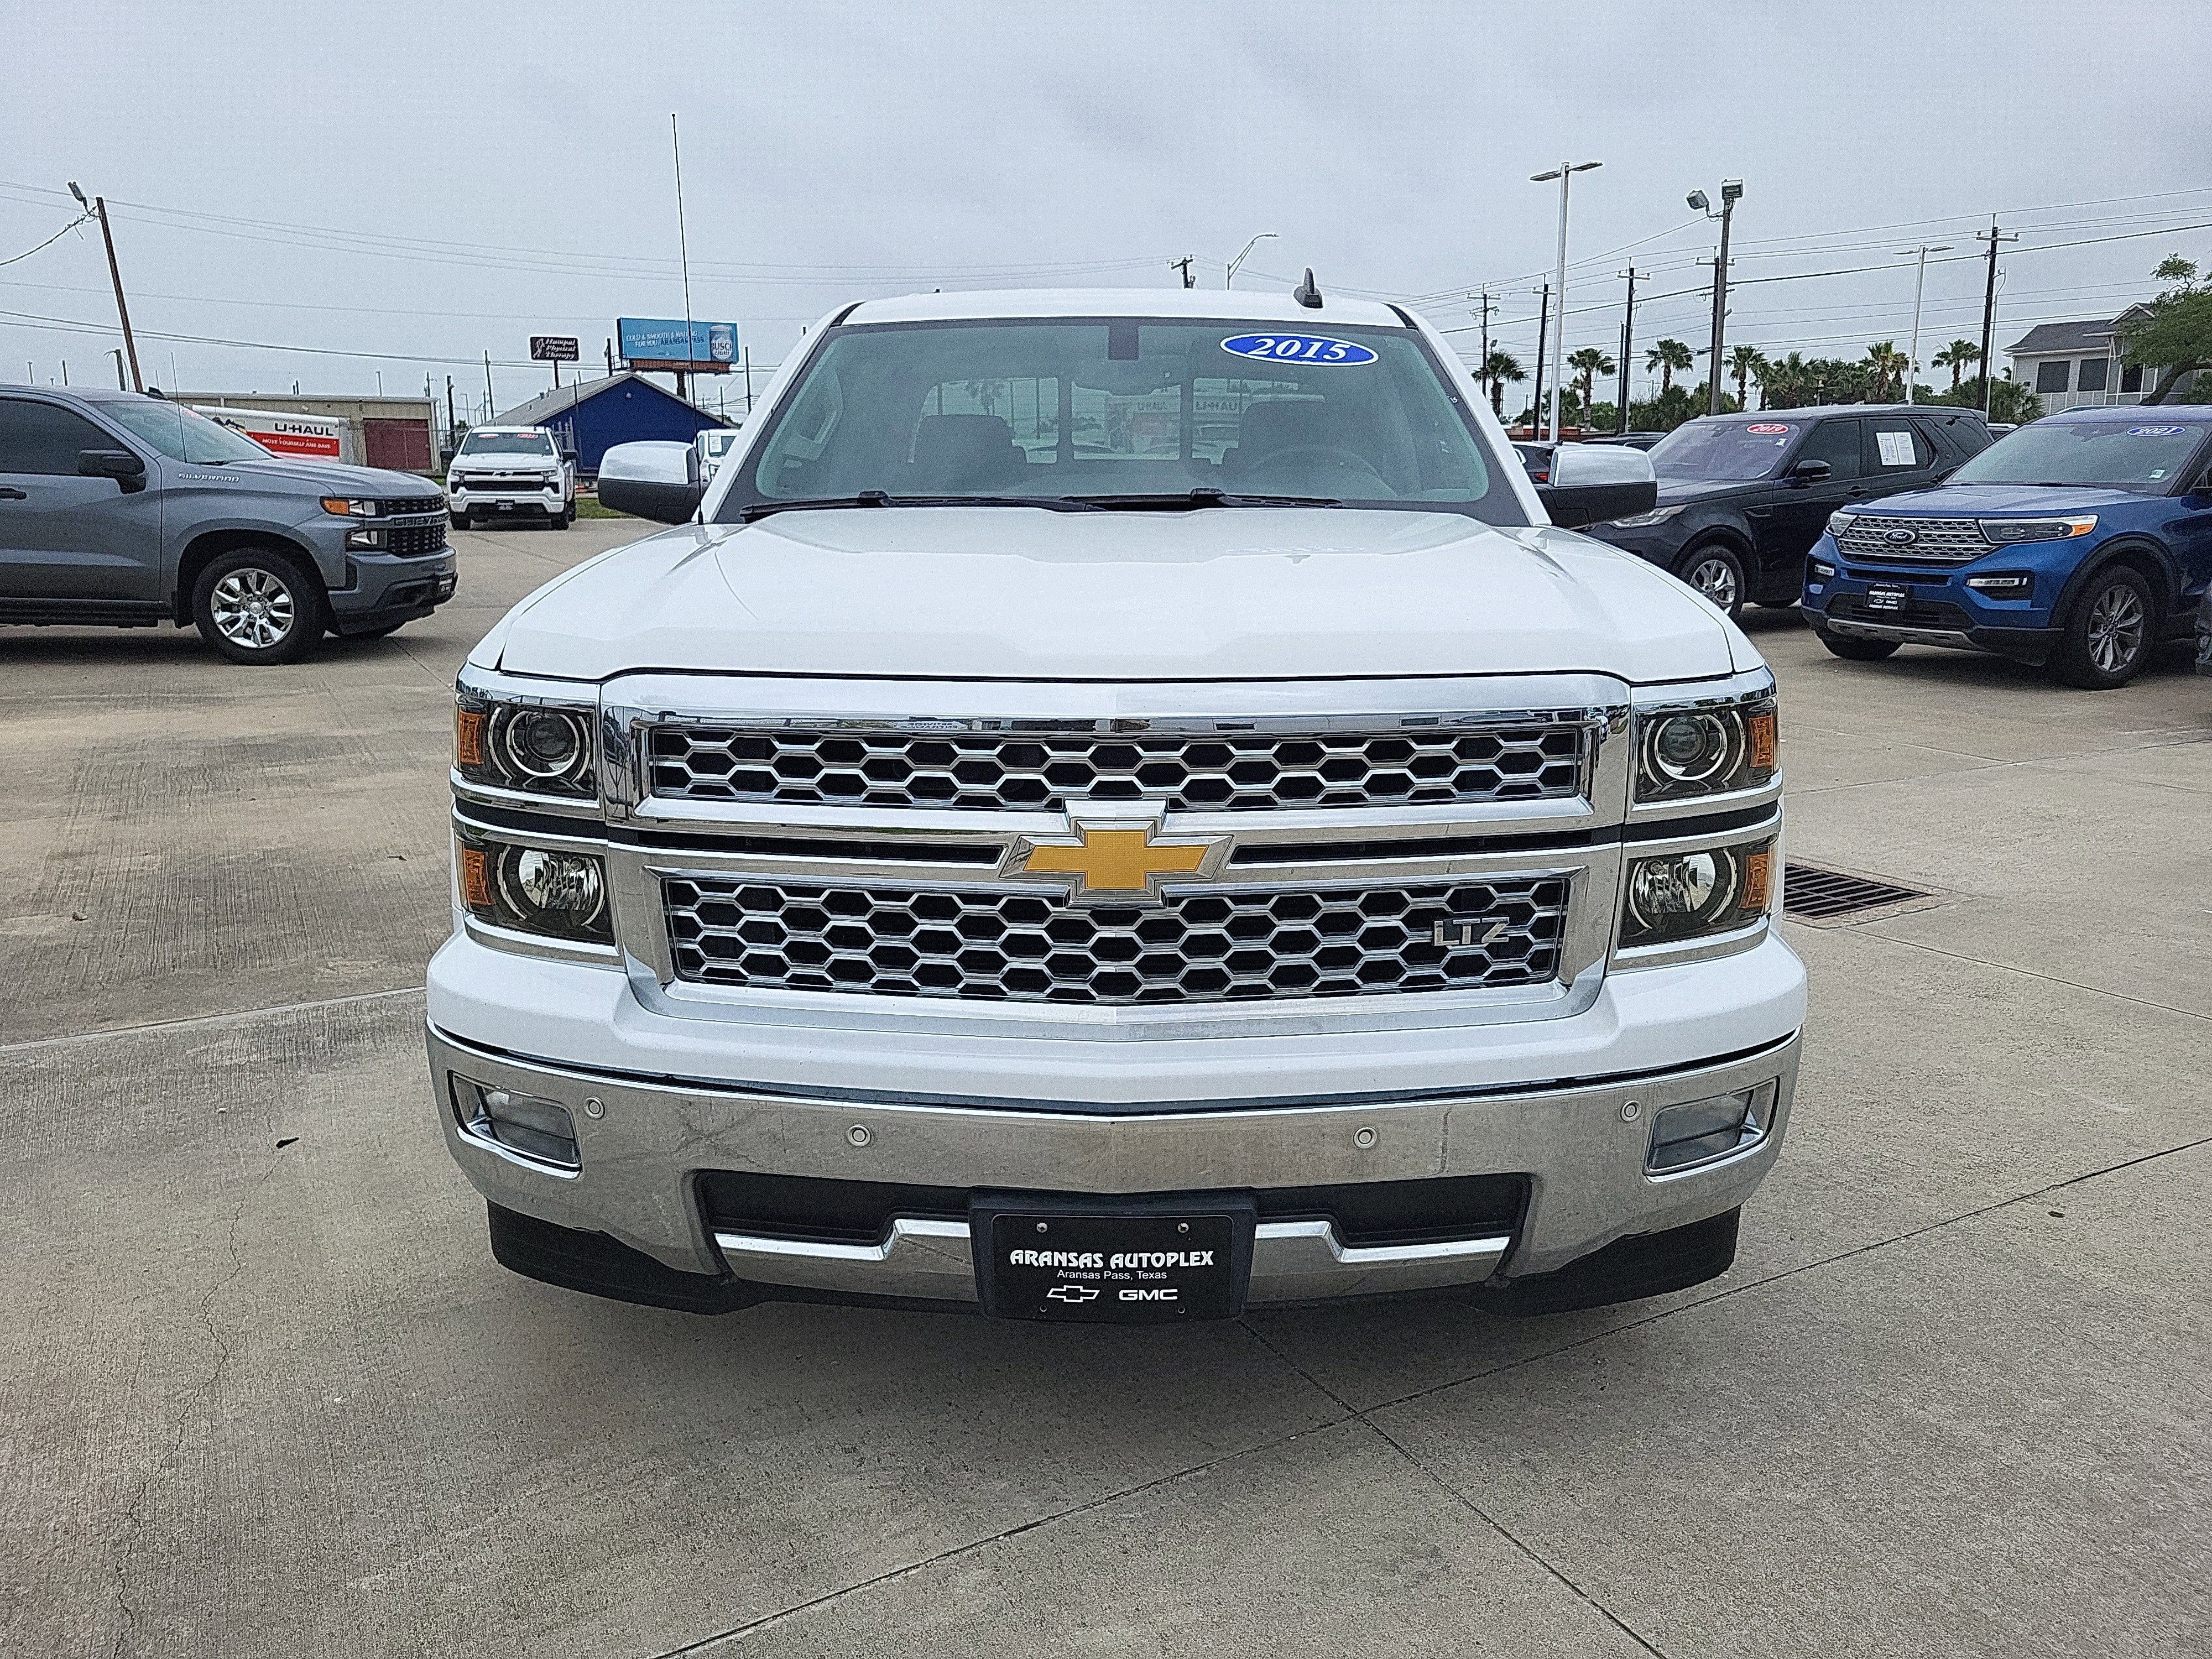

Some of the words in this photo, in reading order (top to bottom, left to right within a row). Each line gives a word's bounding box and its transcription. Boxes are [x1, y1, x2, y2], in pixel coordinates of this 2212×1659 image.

[1247, 338, 1351, 360] 2015
[274, 422, 334, 436] U-HAUL
[1434, 916, 1510, 946] LTZ
[1010, 1249, 1104, 1269] ARANSAS
[1110, 1250, 1214, 1269] AUTOPLEX
[1057, 1270, 1100, 1280] Aransas
[1104, 1271, 1133, 1281] Pass,
[1136, 1270, 1167, 1280] Texas
[1119, 1288, 1178, 1301] GMC
